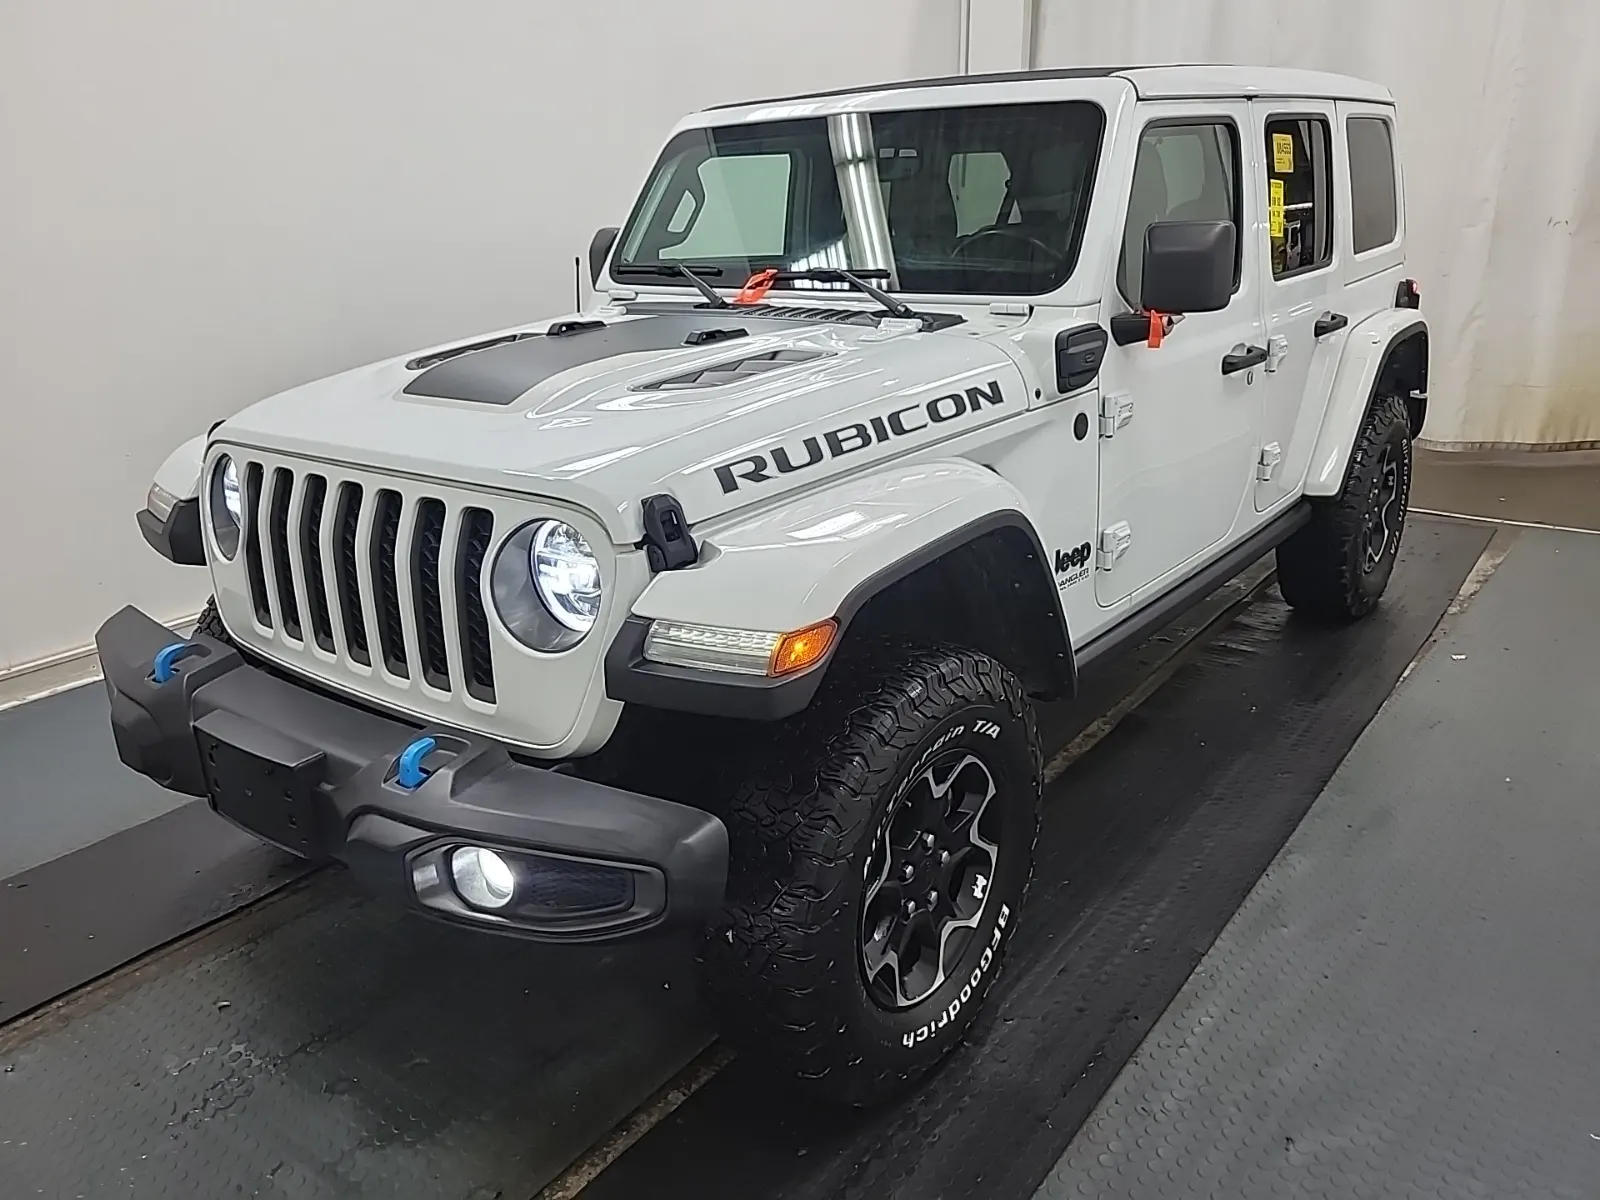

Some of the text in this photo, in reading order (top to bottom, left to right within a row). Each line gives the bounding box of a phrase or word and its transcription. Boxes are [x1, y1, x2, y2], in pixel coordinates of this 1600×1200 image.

[713, 380, 1005, 494] RUBICON
[1054, 541, 1092, 576] Jeep
[972, 720, 1001, 739] T/A
[903, 903, 1011, 1048] BFGoodrich
